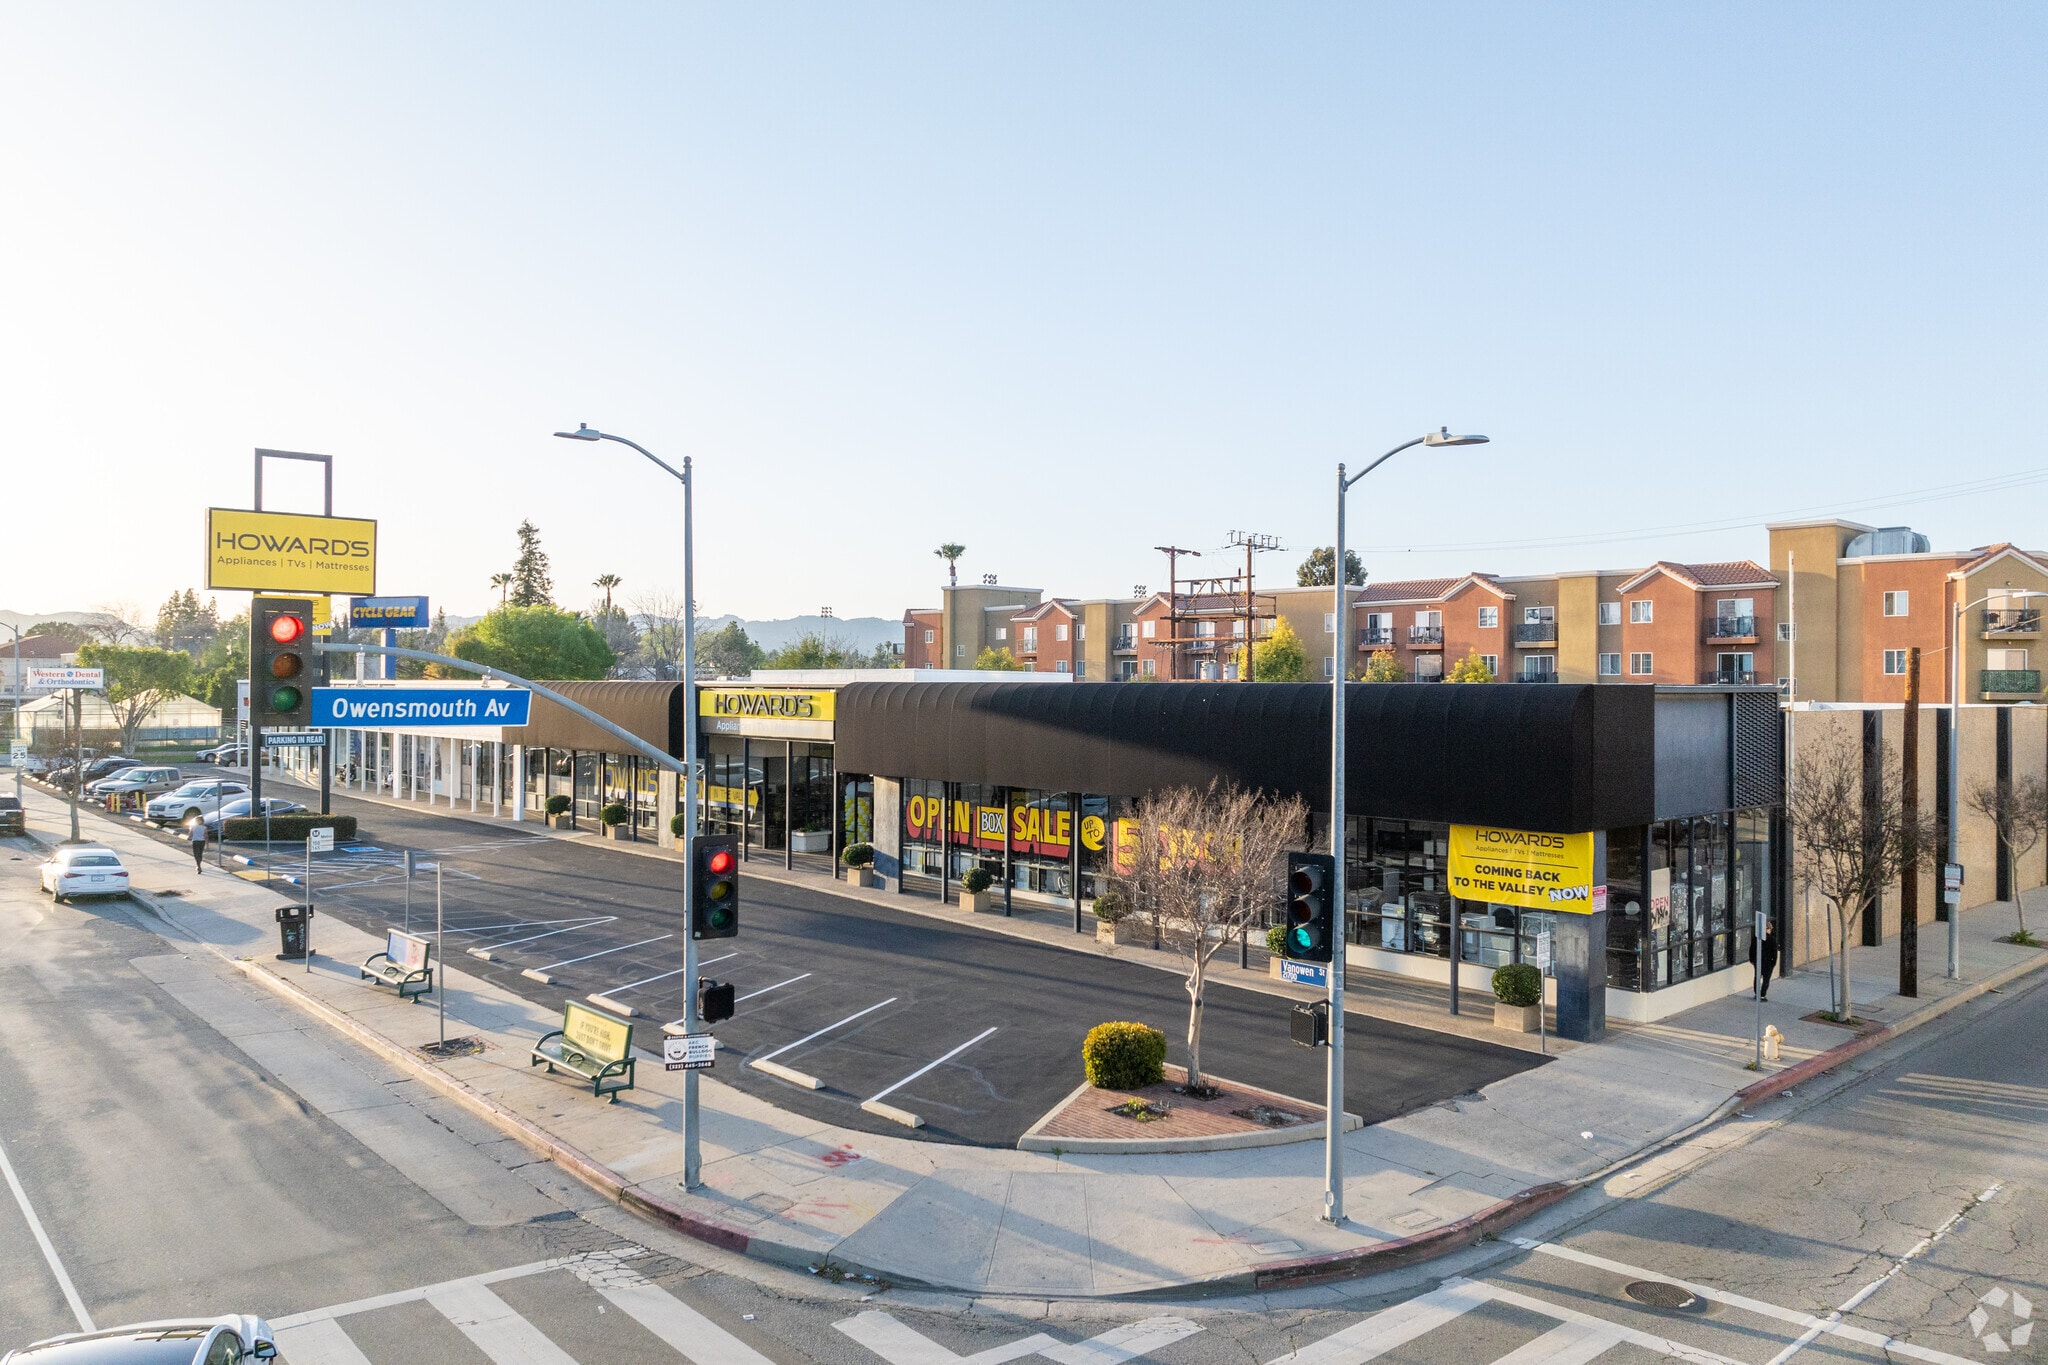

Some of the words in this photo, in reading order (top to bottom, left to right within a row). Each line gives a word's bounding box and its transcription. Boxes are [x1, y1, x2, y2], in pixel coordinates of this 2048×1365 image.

[217, 532, 370, 558] HOWARD'S
[217, 555, 277, 567] Appliances
[287, 559, 306, 568] TVs
[316, 561, 370, 572] Mattresses
[352, 606, 384, 618] CYCLE
[385, 605, 417, 618] GEAR
[33, 670, 65, 678] Western
[75, 670, 101, 678] Dental
[332, 697, 477, 718] Owensmouth
[484, 698, 510, 717] Av
[268, 736, 297, 745] PARKING
[297, 736, 305, 744] IN
[306, 735, 323, 744] REAR
[981, 811, 1004, 833] BOX
[1013, 805, 1071, 846] SALE
[1084, 819, 1094, 830] UP
[1086, 828, 1100, 839] TO
[1475, 829, 1565, 849] HOWARD'S
[1475, 845, 1509, 854] Appliances
[1513, 848, 1525, 856] TVs
[1531, 850, 1564, 860] Mattresses
[1475, 864, 1522, 878] COMING
[1525, 869, 1561, 882] BACK
[1454, 876, 1470, 887] TO
[1473, 878, 1495, 890] THE
[1498, 881, 1545, 896] VALLEY
[1549, 884, 1590, 902] NOW
[1282, 960, 1314, 977] Vanowen
[1318, 967, 1326, 977] St
